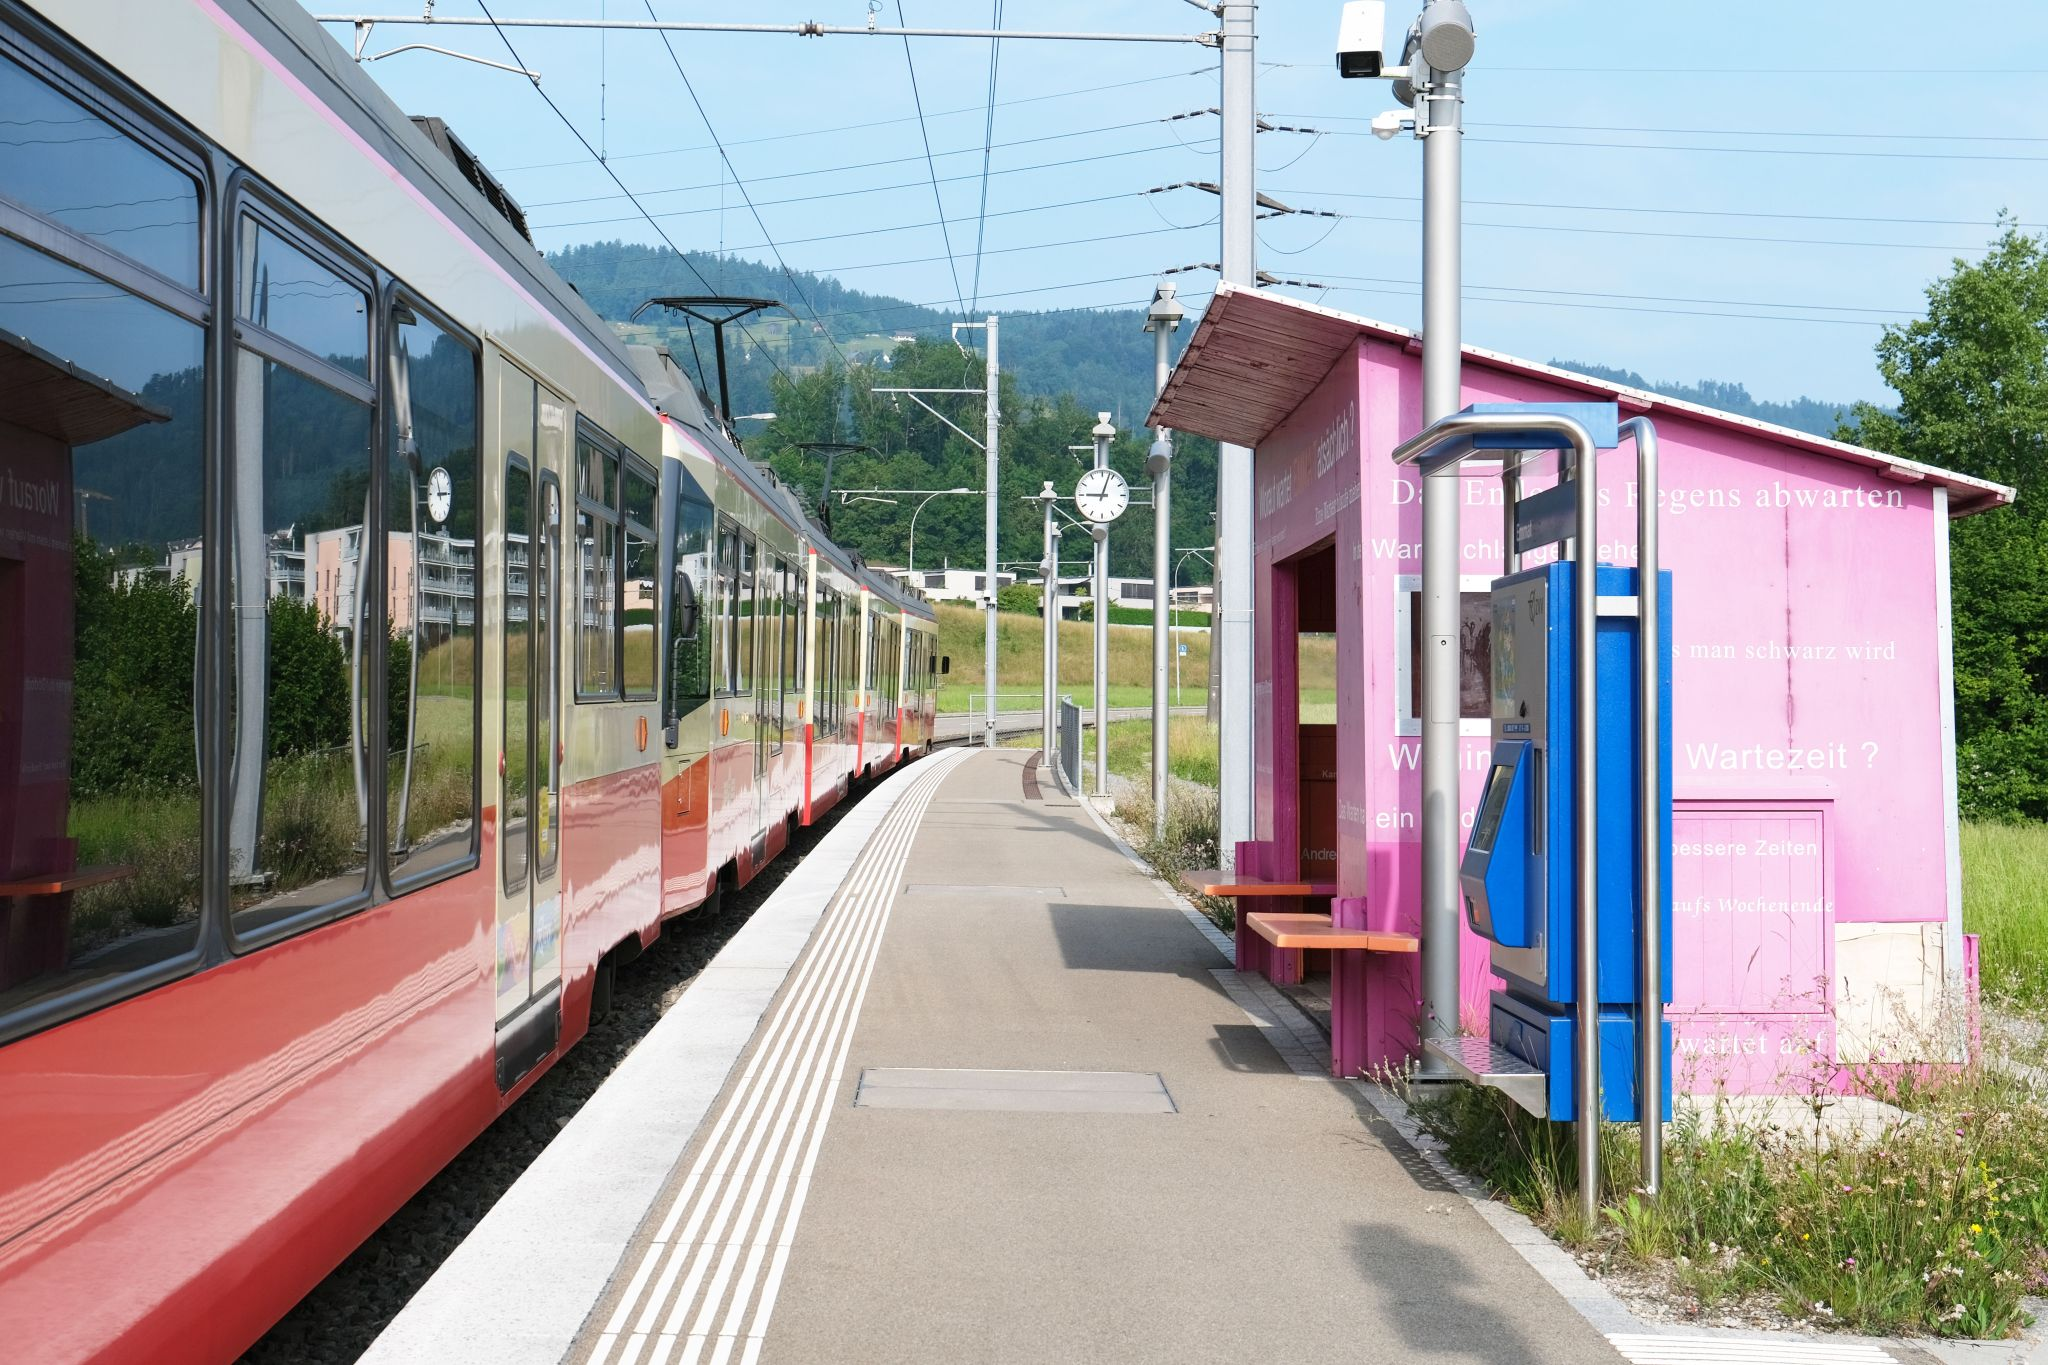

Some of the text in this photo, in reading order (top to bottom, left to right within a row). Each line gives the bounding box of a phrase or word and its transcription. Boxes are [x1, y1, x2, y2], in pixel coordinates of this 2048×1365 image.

[1755, 480, 1904, 508] abwarten
[1689, 644, 1736, 659] man
[1744, 640, 1837, 660] schwarz
[1846, 640, 1896, 660] wird
[1685, 742, 1847, 770] Wartezeit
[1861, 741, 1879, 769] ?
[1376, 807, 1414, 829] ein
[1754, 839, 1818, 857] Zeiten
[1719, 896, 1834, 913] Wochenende
[1679, 1032, 1768, 1056] wartet
